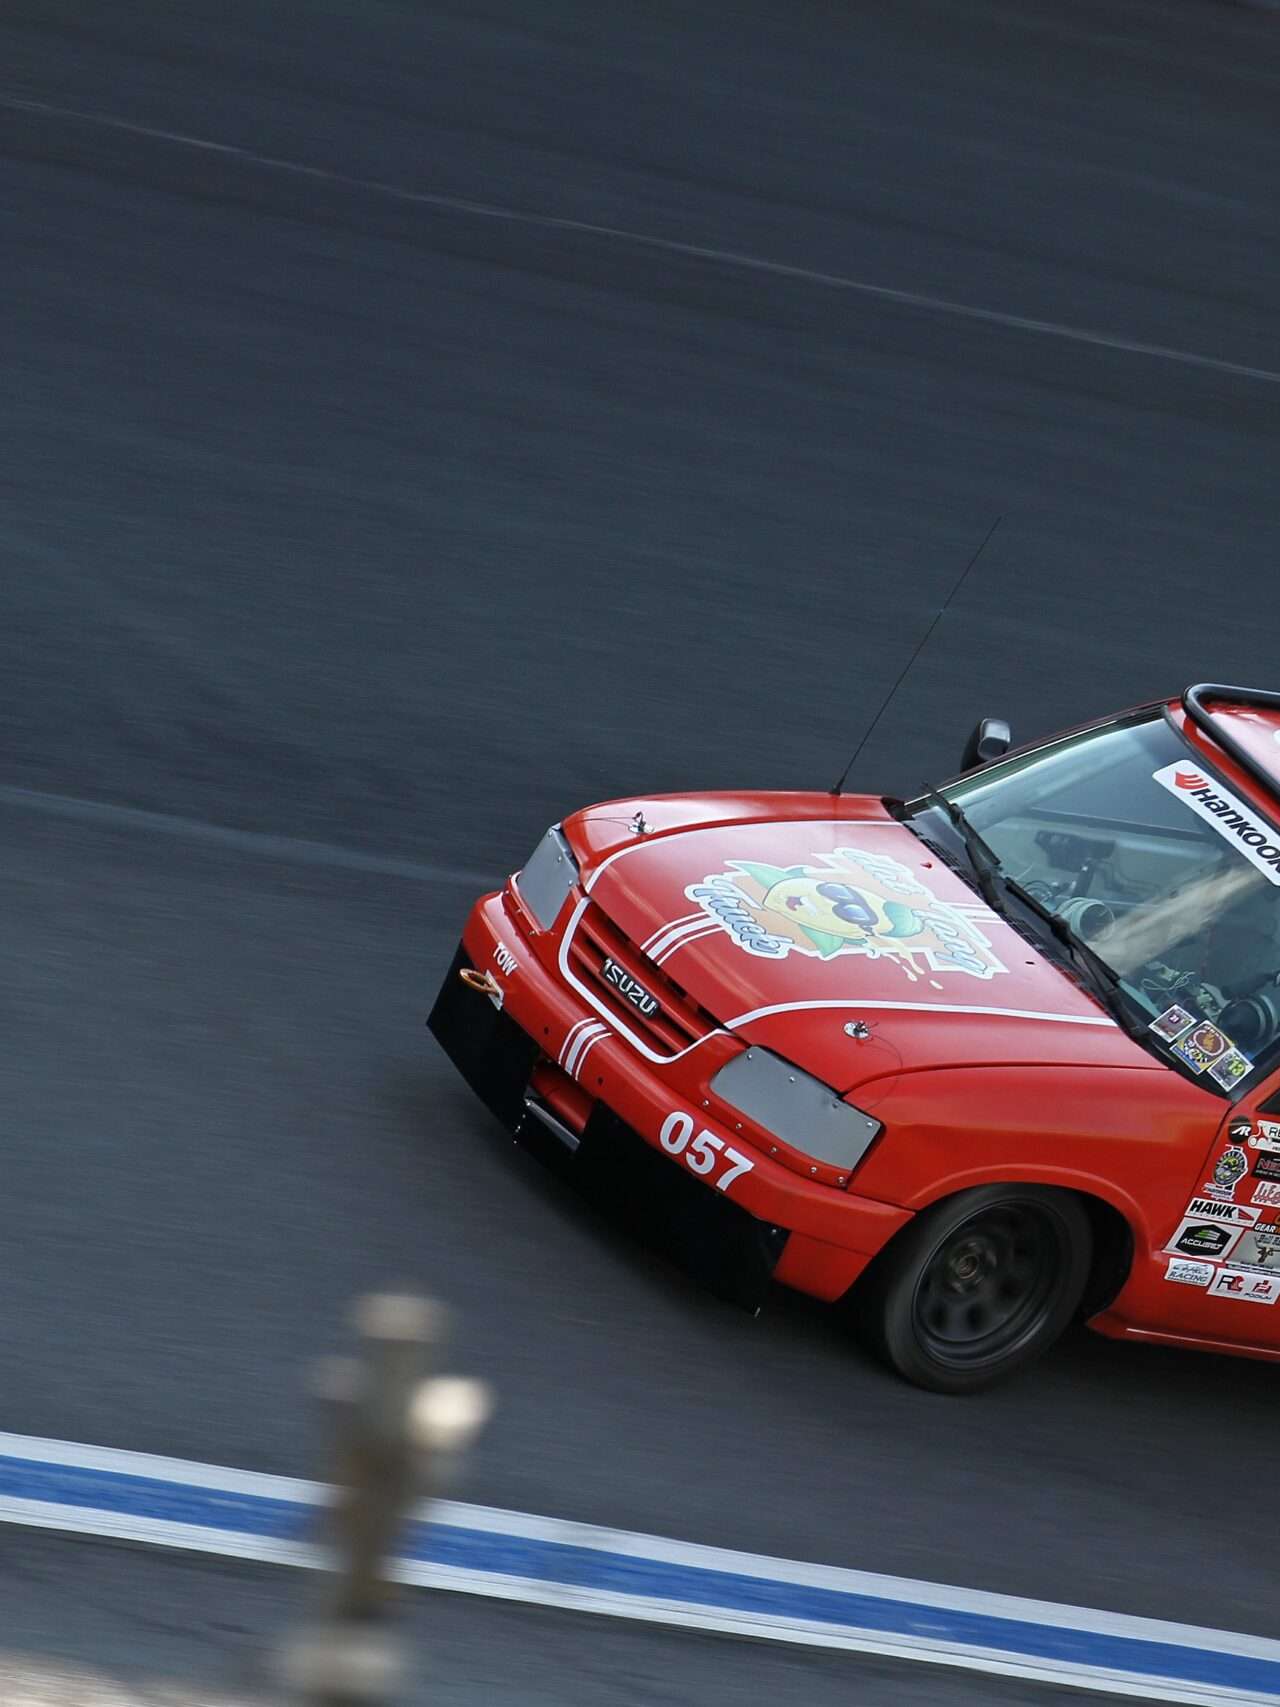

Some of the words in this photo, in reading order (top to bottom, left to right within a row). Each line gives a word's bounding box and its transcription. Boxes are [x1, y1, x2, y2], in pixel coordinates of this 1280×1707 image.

[693, 877, 795, 955] Truck
[492, 942, 518, 977] TOW
[602, 957, 658, 1016] ISUZU
[659, 1111, 755, 1192] 057
[1189, 1200, 1236, 1219] HAWK
